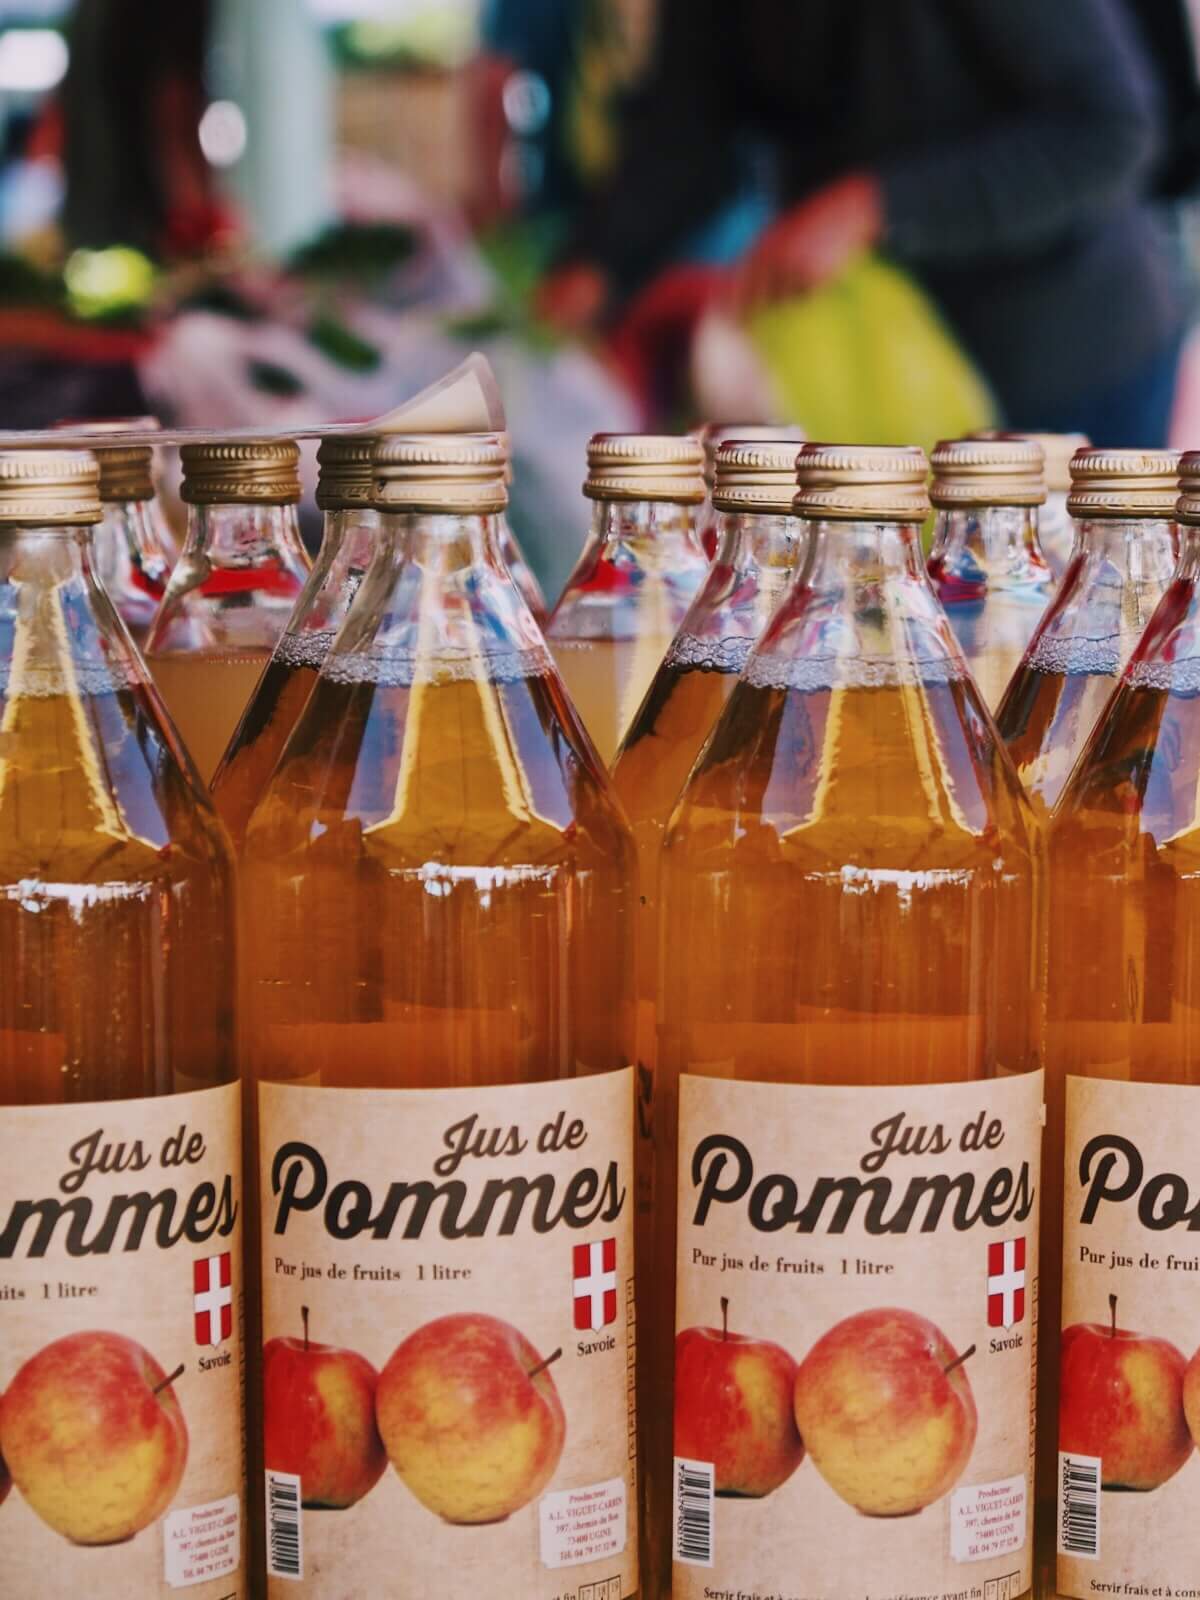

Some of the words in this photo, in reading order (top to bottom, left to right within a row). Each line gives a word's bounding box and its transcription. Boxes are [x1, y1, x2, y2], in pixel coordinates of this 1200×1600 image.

[433, 1113, 528, 1177] Jus
[537, 1111, 587, 1153] de
[860, 1111, 952, 1173] Jus
[959, 1110, 1005, 1152] de
[59, 1129, 151, 1194] Jus
[160, 1125, 207, 1168] de
[272, 1141, 626, 1240] Pommes
[691, 1134, 1035, 1234] Pommes
[0, 1175, 238, 1259] mmes
[274, 1257, 297, 1277] Pur
[300, 1261, 322, 1281] jus
[327, 1262, 348, 1280] de
[353, 1264, 401, 1281] fruits
[416, 1264, 426, 1281] 1
[431, 1263, 473, 1281] litre
[692, 1248, 717, 1267] Pur
[720, 1253, 744, 1272] jus
[750, 1256, 769, 1273] de
[776, 1256, 825, 1275] fruits
[840, 1259, 849, 1275] 1
[855, 1259, 895, 1275] litre
[1079, 1246, 1106, 1265] Pur
[1109, 1250, 1134, 1270] jus
[1139, 1253, 1159, 1270] de
[0, 1284, 25, 1300] its
[43, 1283, 50, 1299] 1
[58, 1282, 98, 1299] litre
[577, 1335, 616, 1356] Savoie
[989, 1333, 1023, 1354] Savoie
[971, 1586, 982, 1598] fin
[1090, 1578, 1121, 1594] Servir
[1124, 1582, 1149, 1597] frais
[1152, 1586, 1162, 1597] et
[1165, 1585, 1172, 1598] à
